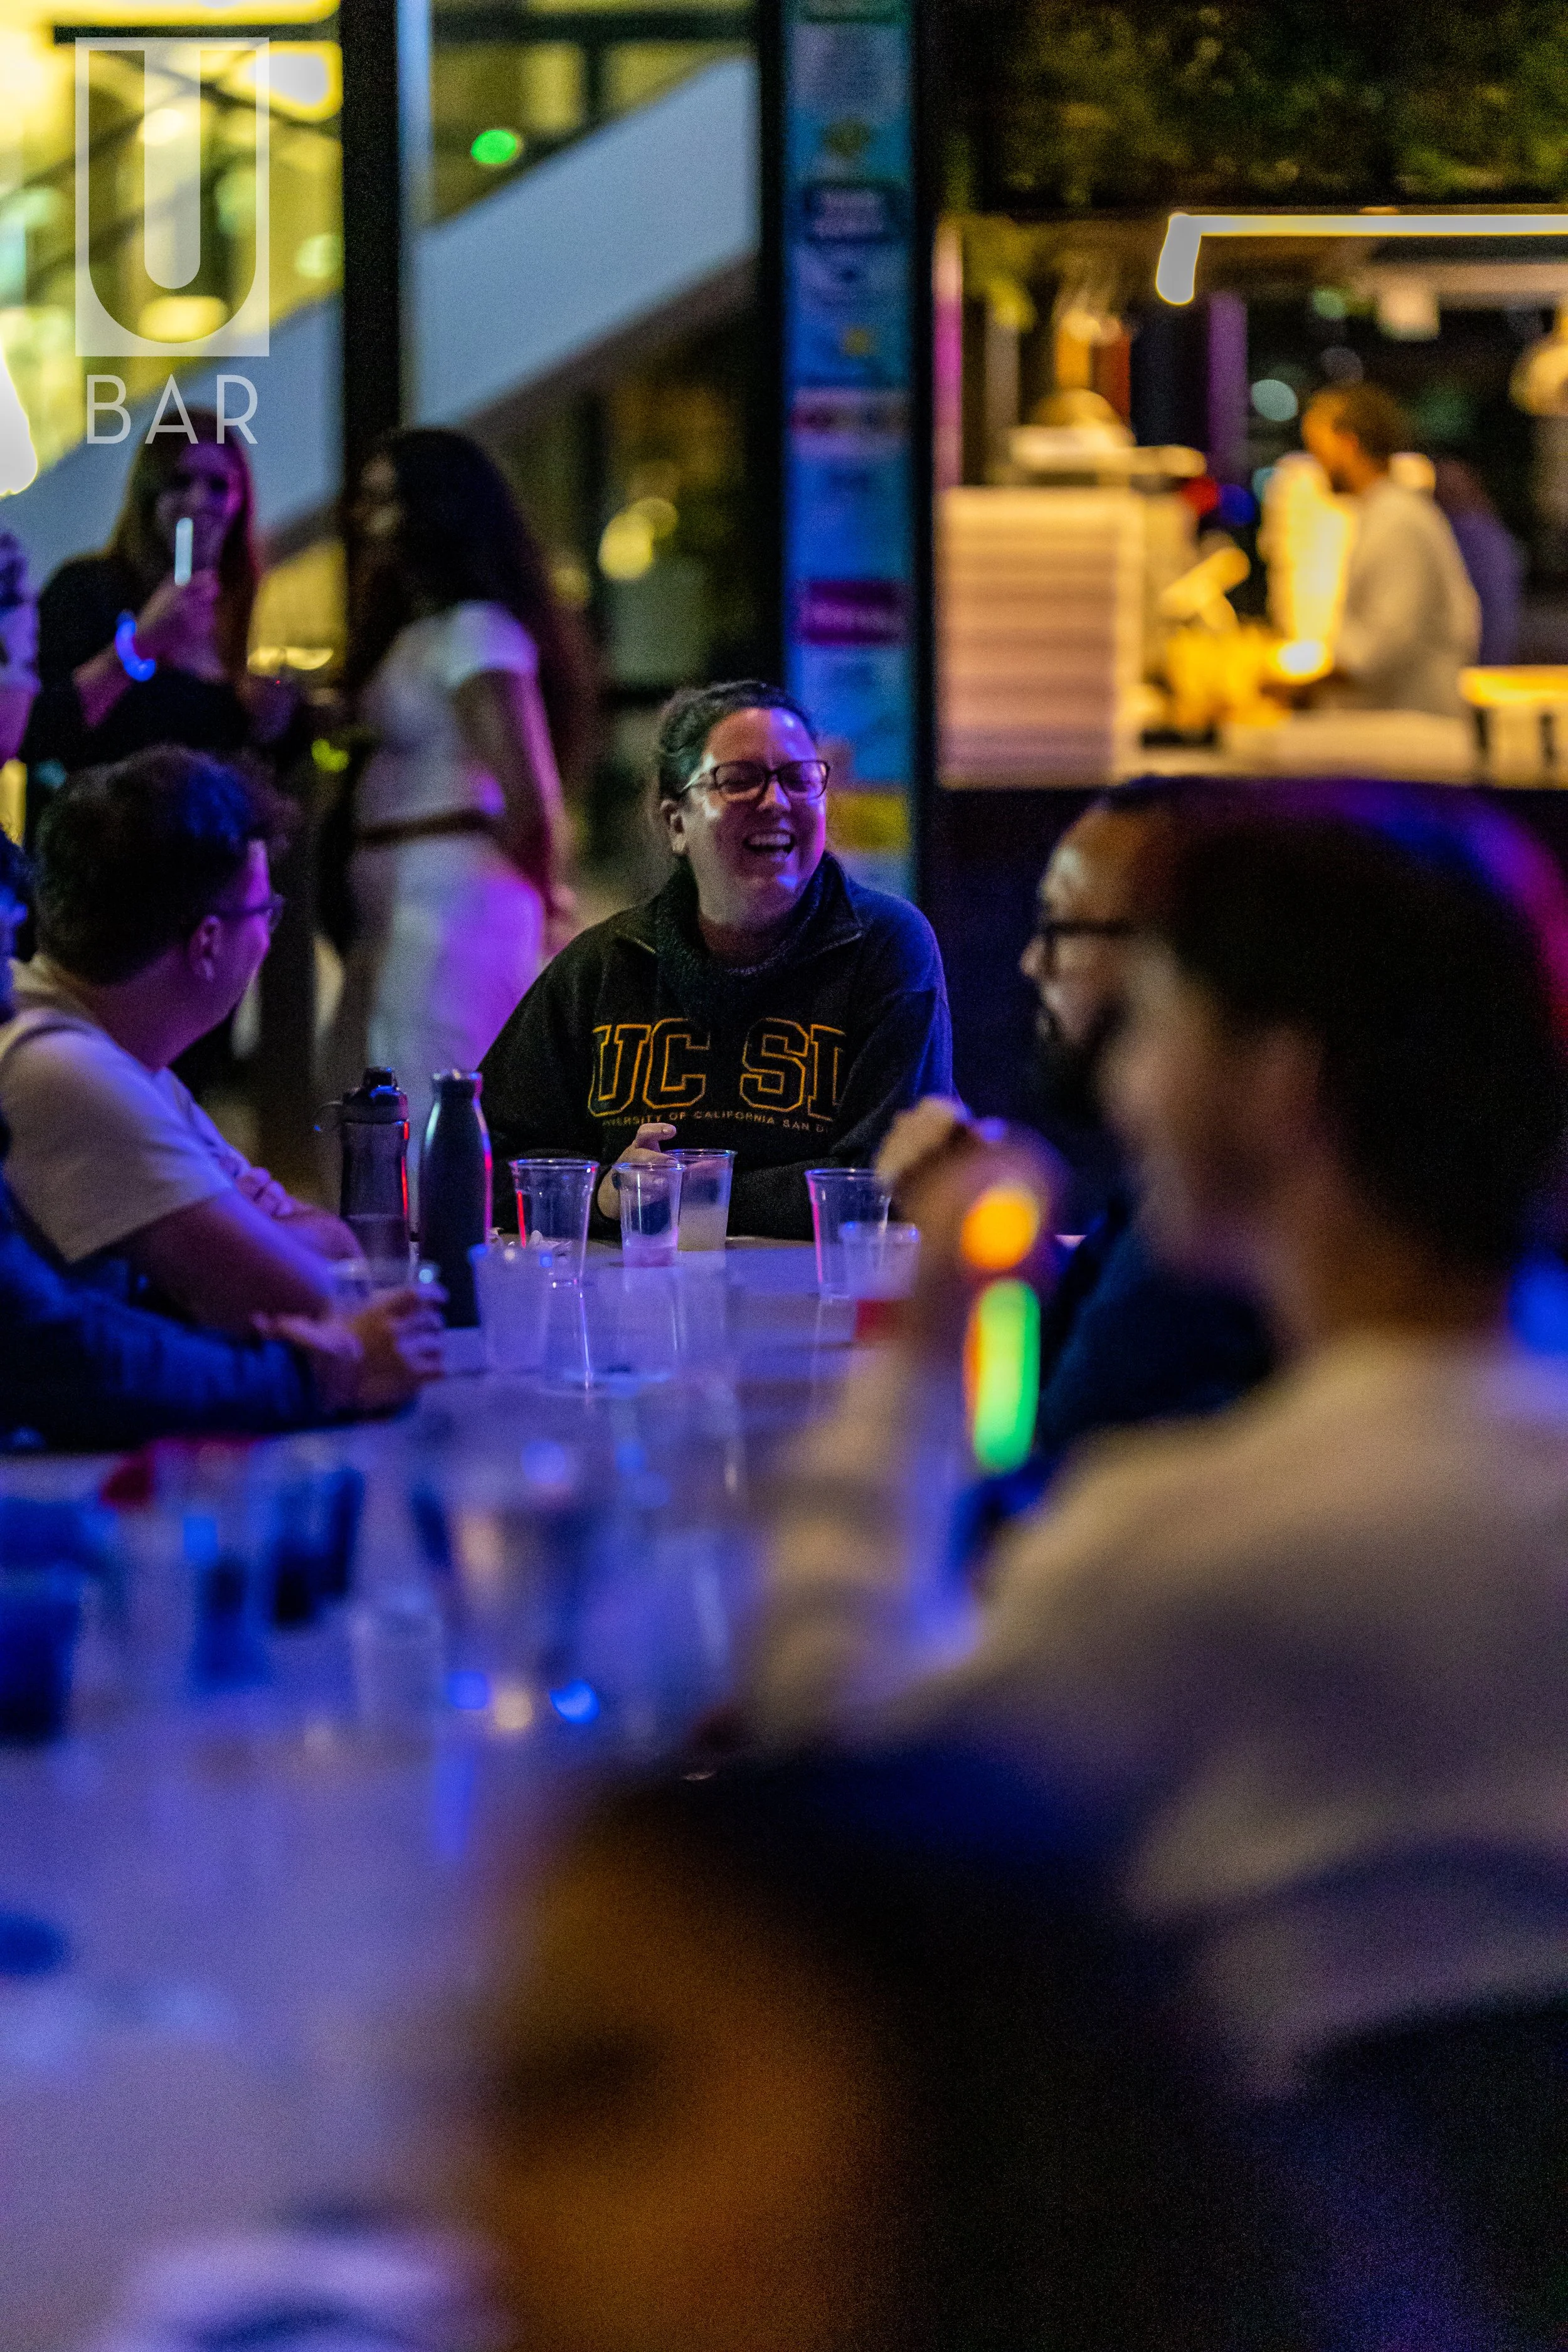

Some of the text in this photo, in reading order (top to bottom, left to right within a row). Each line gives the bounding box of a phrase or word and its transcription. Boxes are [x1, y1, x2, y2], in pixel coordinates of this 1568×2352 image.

[587, 1017, 711, 1118] UC
[668, 1111, 687, 1121] OF
[692, 1110, 776, 1125] CALIFORNIA
[782, 1118, 810, 1131] SAN
